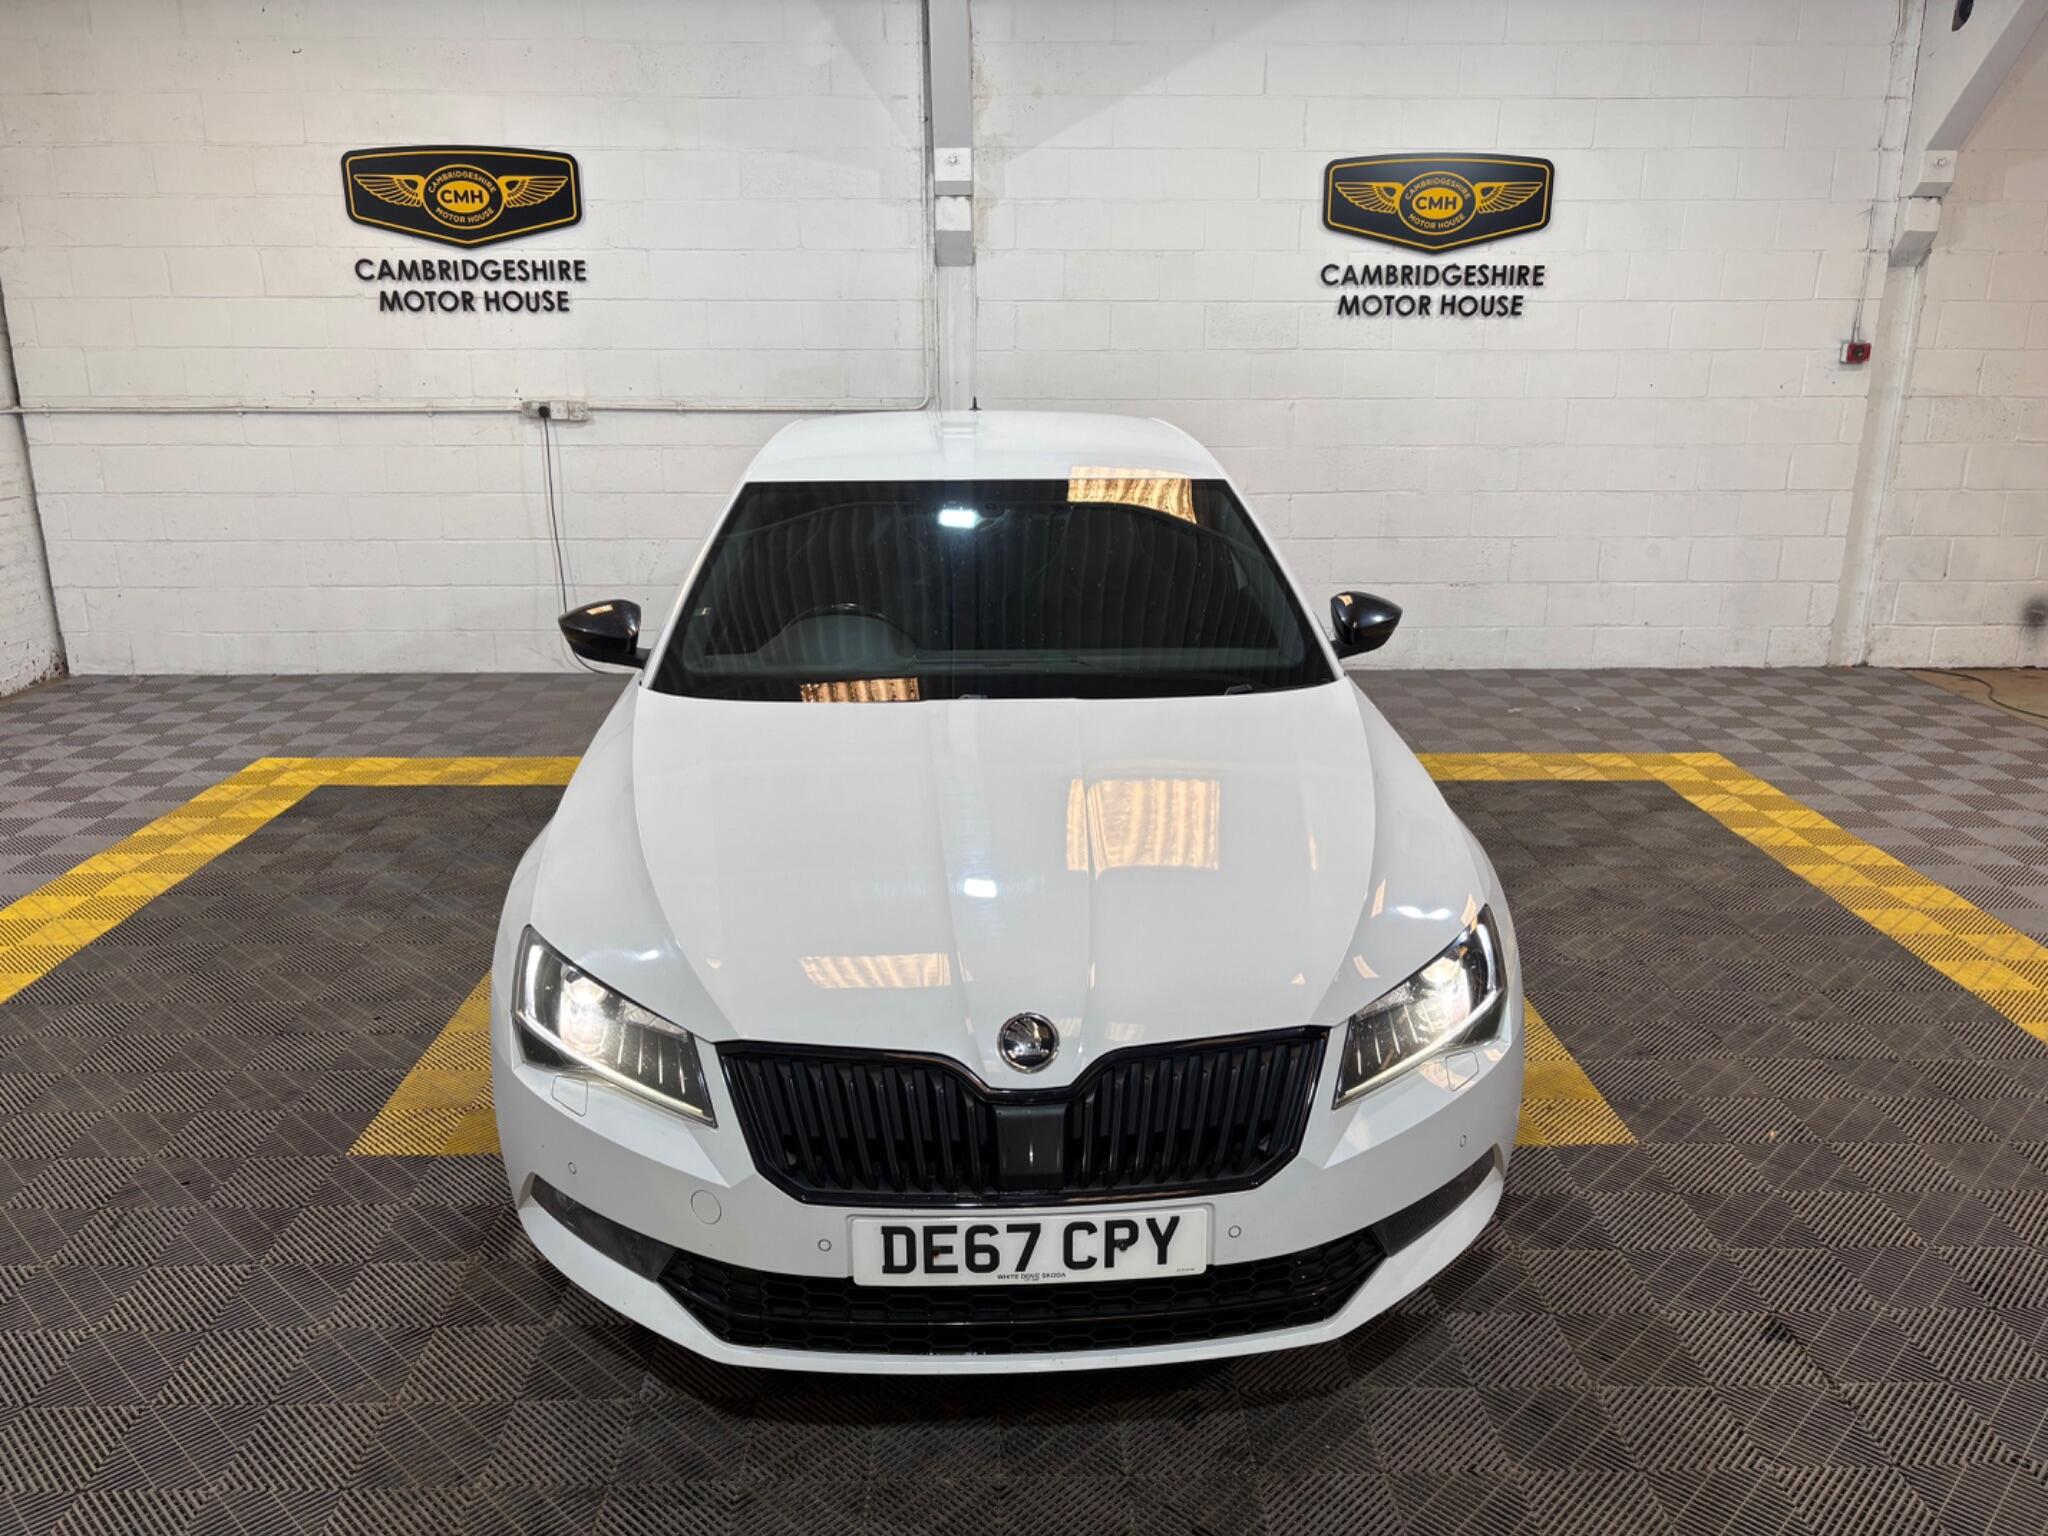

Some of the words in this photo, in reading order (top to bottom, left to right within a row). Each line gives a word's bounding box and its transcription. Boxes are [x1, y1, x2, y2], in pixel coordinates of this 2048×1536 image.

[428, 170, 497, 194] CAMBRIDGESHIRE
[1404, 177, 1472, 200] CAMBRIDGESHIRE
[441, 189, 484, 204] CMH
[1415, 196, 1458, 210] CMH
[435, 207, 466, 223] MOTOR
[467, 206, 495, 223] HOUSE
[1408, 213, 1437, 229] MOTOR
[1438, 212, 1465, 229] HOUSE
[354, 258, 587, 282] CAMBRIDGESHIRE
[1320, 263, 1545, 287] CAMBRIDGESHIRE
[379, 290, 475, 313] MOTOR
[484, 290, 570, 313] HOUSE
[1337, 294, 1431, 317] MOTOR
[1440, 294, 1524, 317] HOUSE
[881, 1222, 1042, 1275] DE67
[1063, 1215, 1181, 1271] CPY
